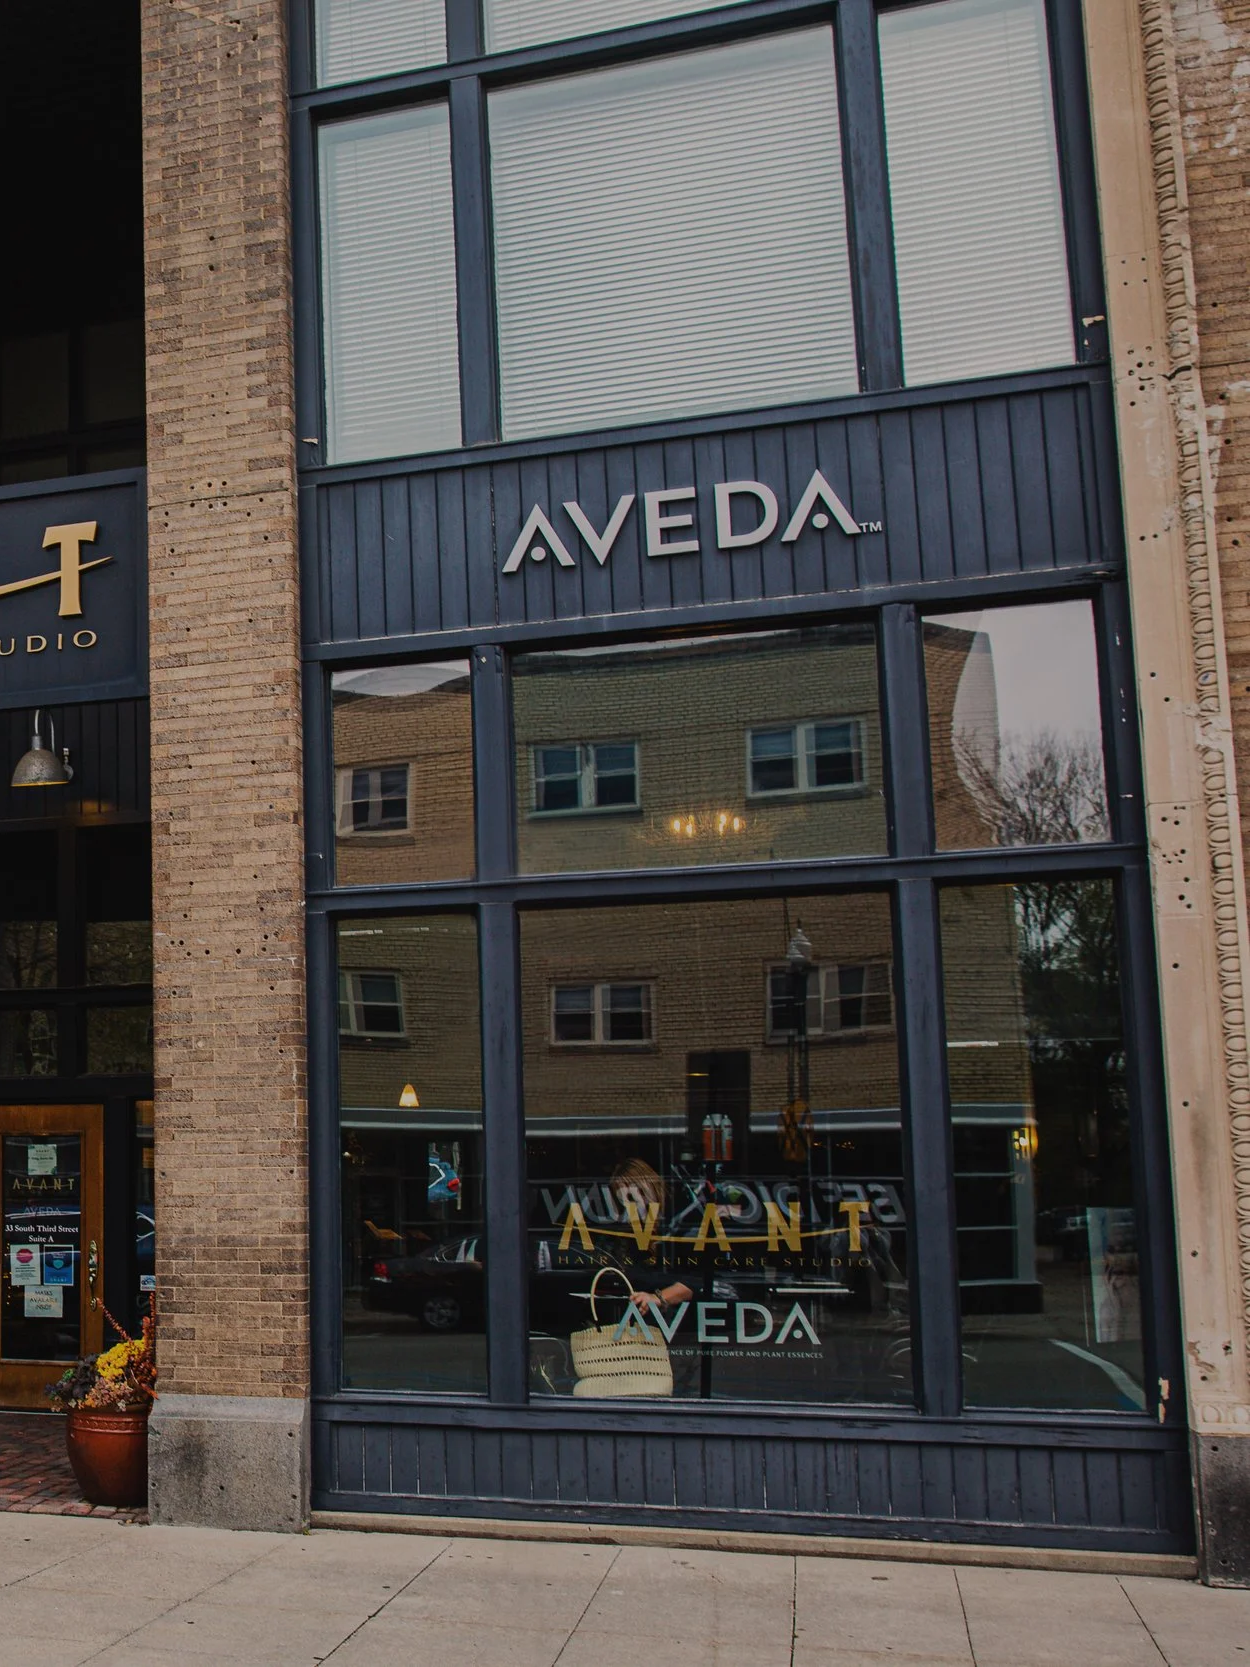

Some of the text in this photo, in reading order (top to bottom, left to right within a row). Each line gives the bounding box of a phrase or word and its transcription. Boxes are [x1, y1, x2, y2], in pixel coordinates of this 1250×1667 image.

[502, 467, 862, 574] AVEDA
[12, 1177, 75, 1190] AVANT
[5, 1224, 79, 1233] 33 South Third Street
[558, 1201, 871, 1252] AVANT
[28, 1234, 55, 1243] Suite A
[558, 1255, 608, 1265] HAIR
[649, 1256, 699, 1265] SKIN
[713, 1256, 768, 1265] CARE
[783, 1257, 872, 1267] STUDIO
[612, 1301, 822, 1345] AVEDA
